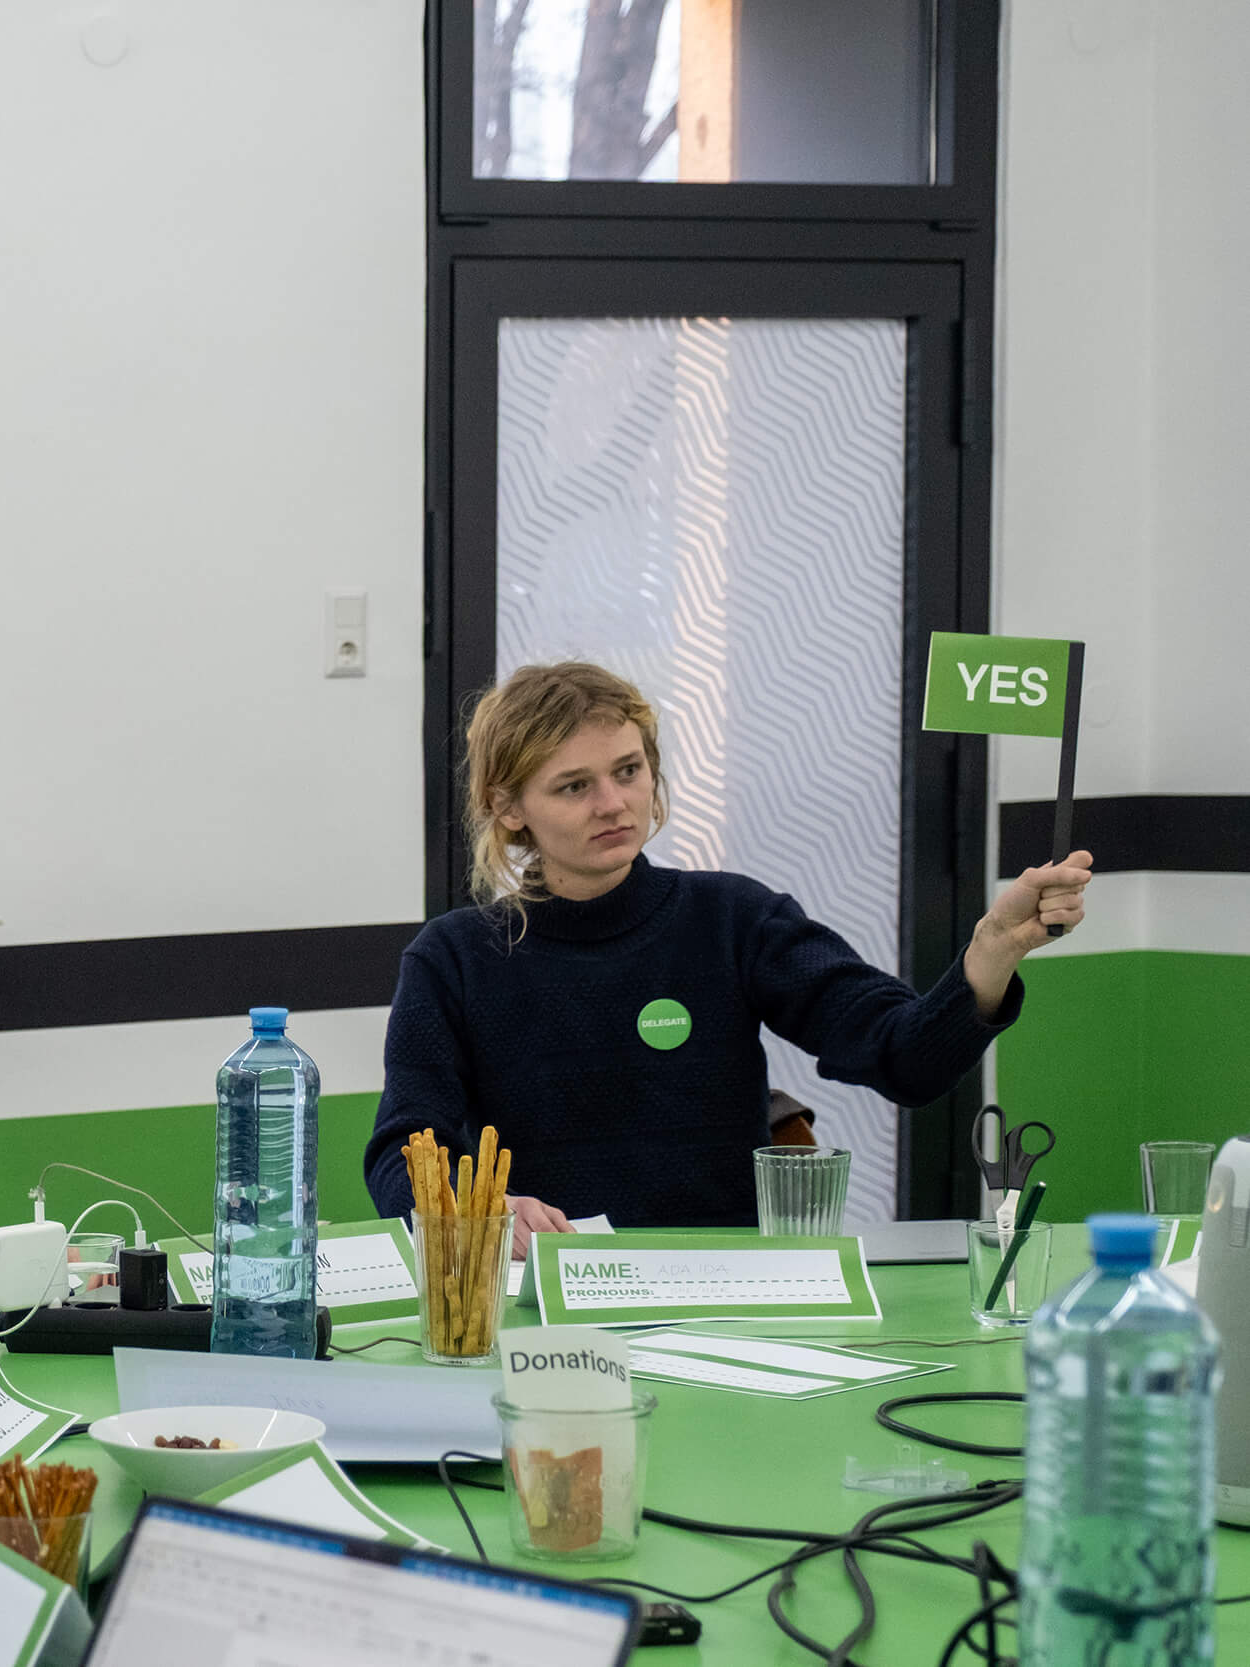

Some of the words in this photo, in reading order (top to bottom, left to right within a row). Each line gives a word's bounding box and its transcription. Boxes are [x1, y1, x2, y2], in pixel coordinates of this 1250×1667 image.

[957, 662, 1049, 706] YES
[641, 1017, 687, 1028] DELEGATE
[564, 1263, 640, 1279] NAME:
[566, 1288, 655, 1297] PRONOUNS:
[510, 1349, 626, 1382] Donations
